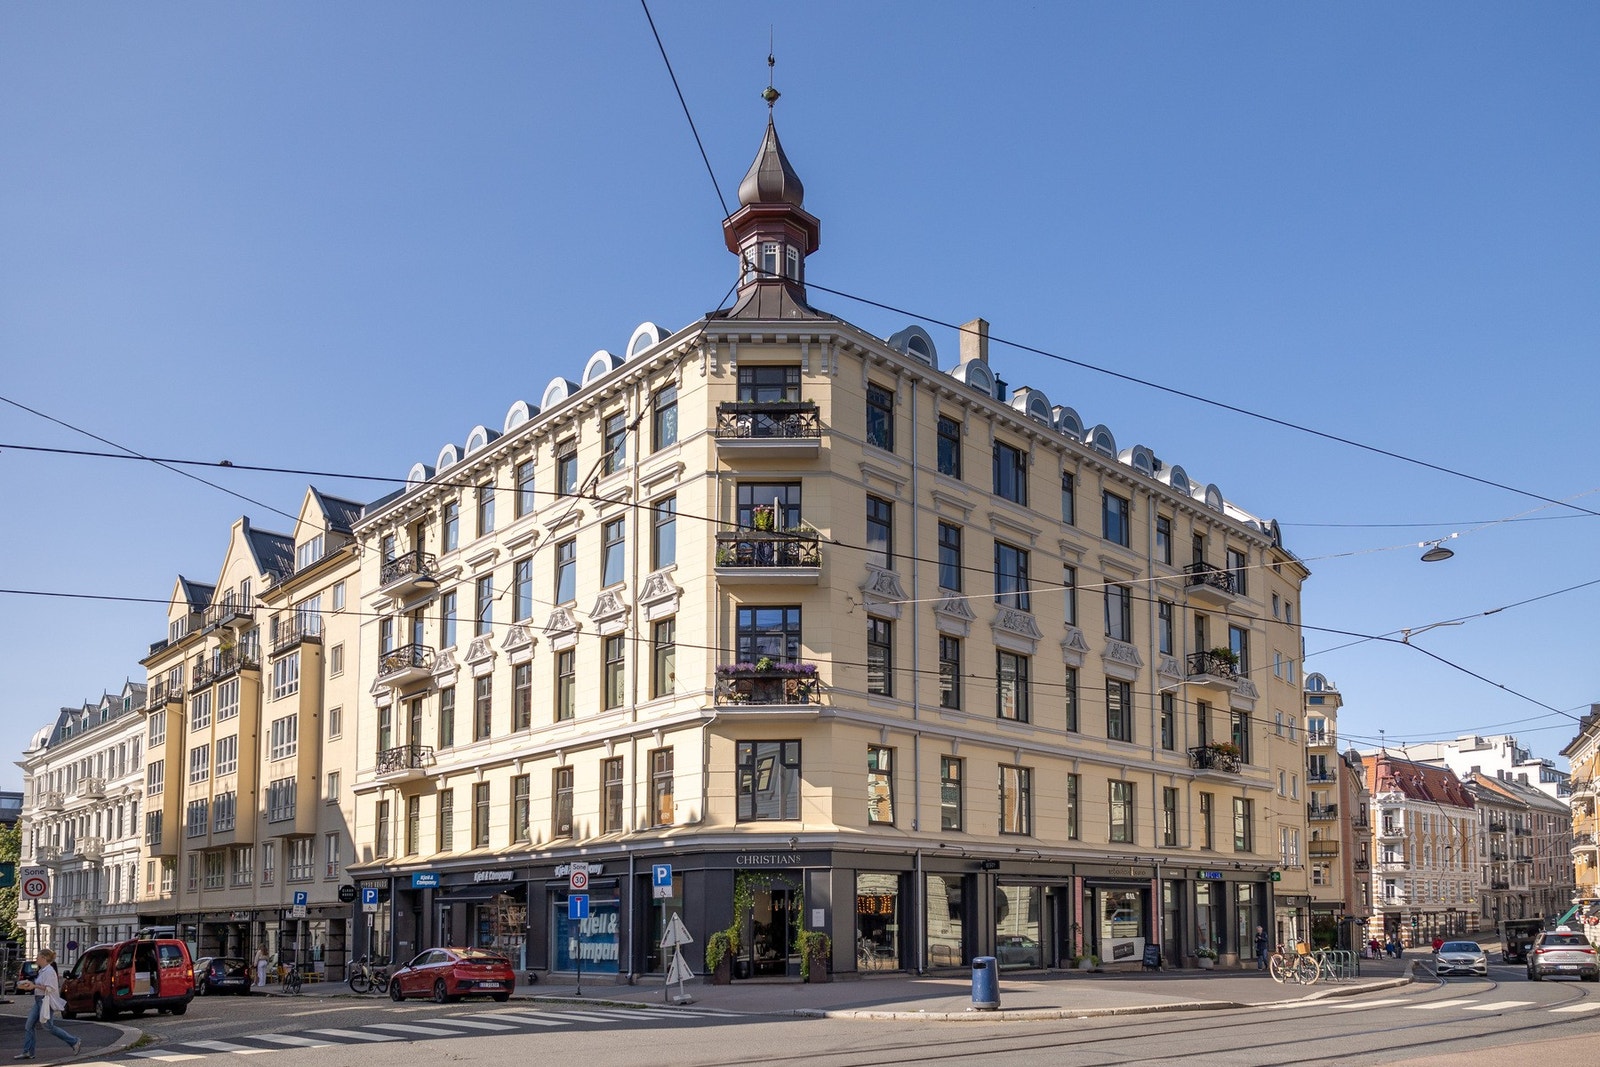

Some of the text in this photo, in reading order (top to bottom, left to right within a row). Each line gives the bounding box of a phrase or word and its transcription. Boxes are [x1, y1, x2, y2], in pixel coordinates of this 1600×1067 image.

[736, 855, 801, 865] CHRISTIANS
[574, 875, 584, 884] 30
[657, 867, 668, 884] P
[29, 883, 43, 891] 30
[296, 892, 305, 904] P
[366, 890, 375, 903] P
[607, 912, 618, 934] &
[568, 937, 620, 963] Compan
